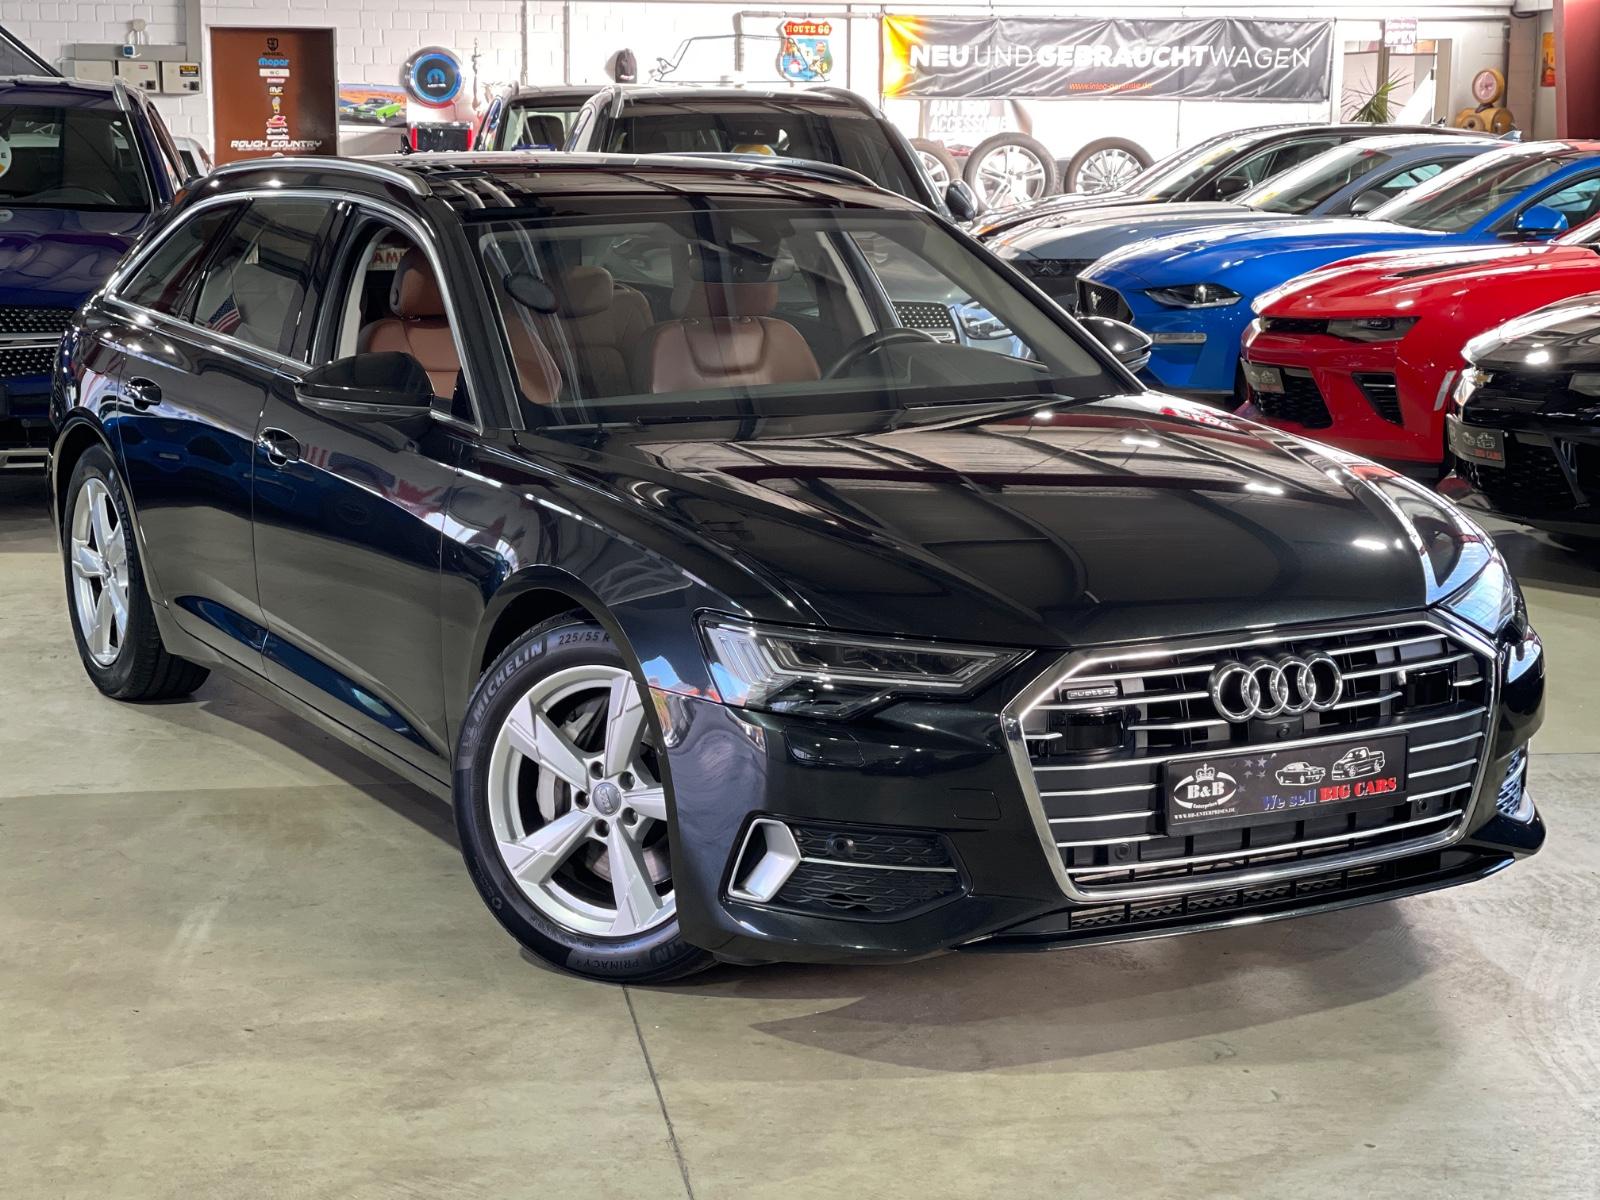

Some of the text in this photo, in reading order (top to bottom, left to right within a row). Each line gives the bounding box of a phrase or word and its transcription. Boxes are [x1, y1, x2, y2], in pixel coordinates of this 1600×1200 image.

[786, 25, 830, 33] ROUTE 66
[559, 631, 599, 645] 225/55
[473, 640, 543, 722] MICHELIN
[1186, 782, 1225, 799] B&B
[1262, 777, 1397, 811] We sell BIG CARS
